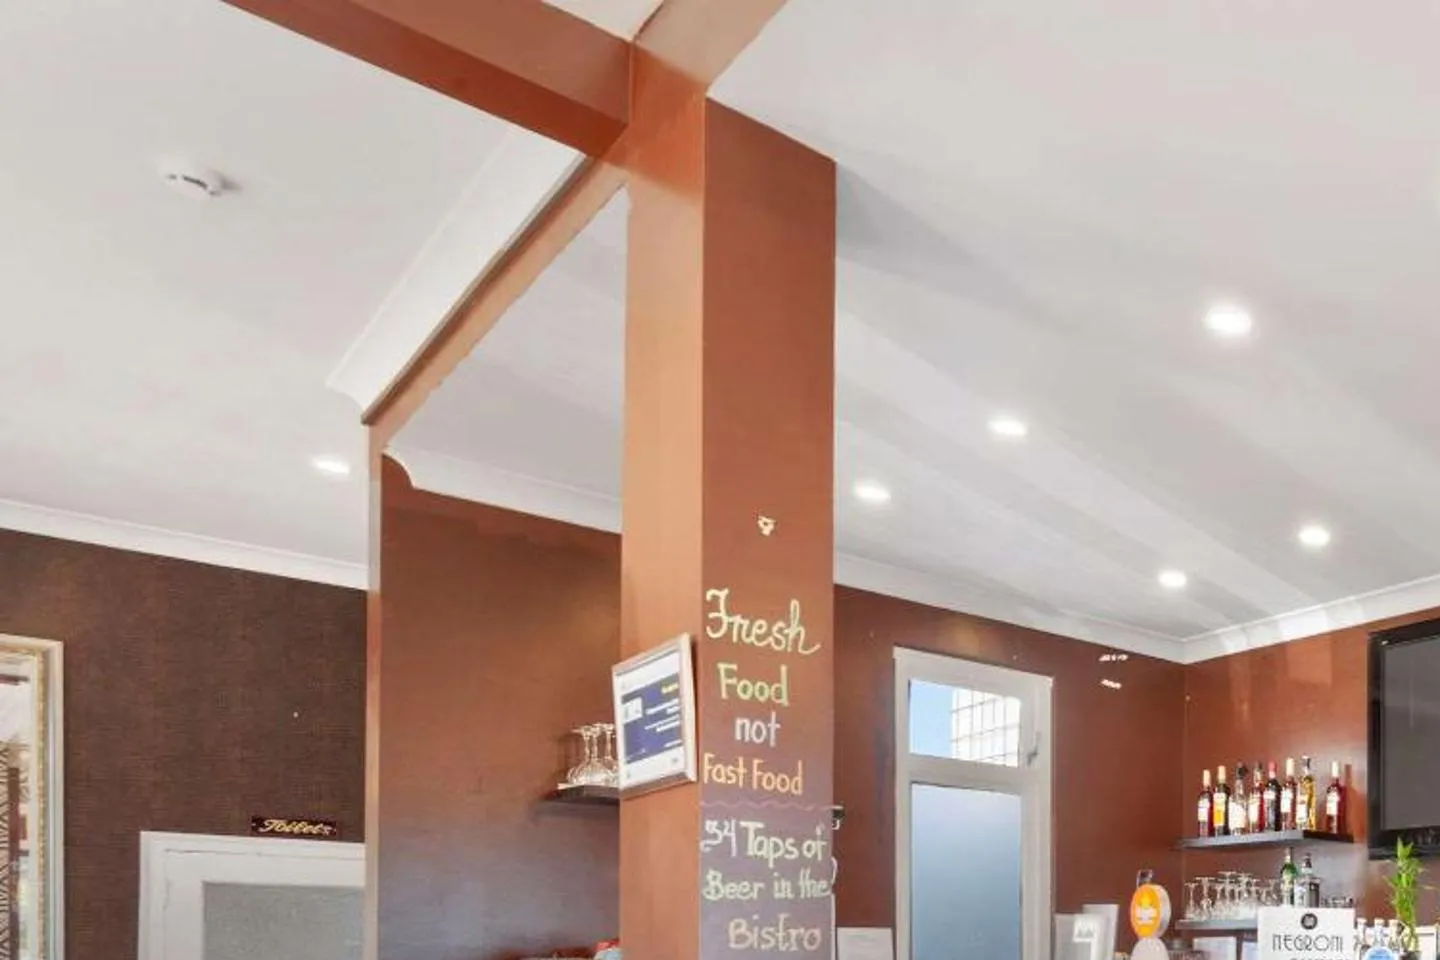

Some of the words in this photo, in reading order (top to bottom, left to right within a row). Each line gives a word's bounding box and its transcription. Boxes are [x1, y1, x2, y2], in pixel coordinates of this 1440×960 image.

[706, 588, 821, 655] Fresh
[717, 662, 789, 707] Food
[734, 711, 781, 747] not
[703, 752, 747, 789] Fast
[752, 759, 803, 796] Food
[740, 820, 800, 869] Taps
[802, 822, 827, 861] of
[702, 868, 765, 901] Beer
[773, 871, 795, 899] in
[797, 866, 832, 898] the
[728, 913, 822, 951] Bistro
